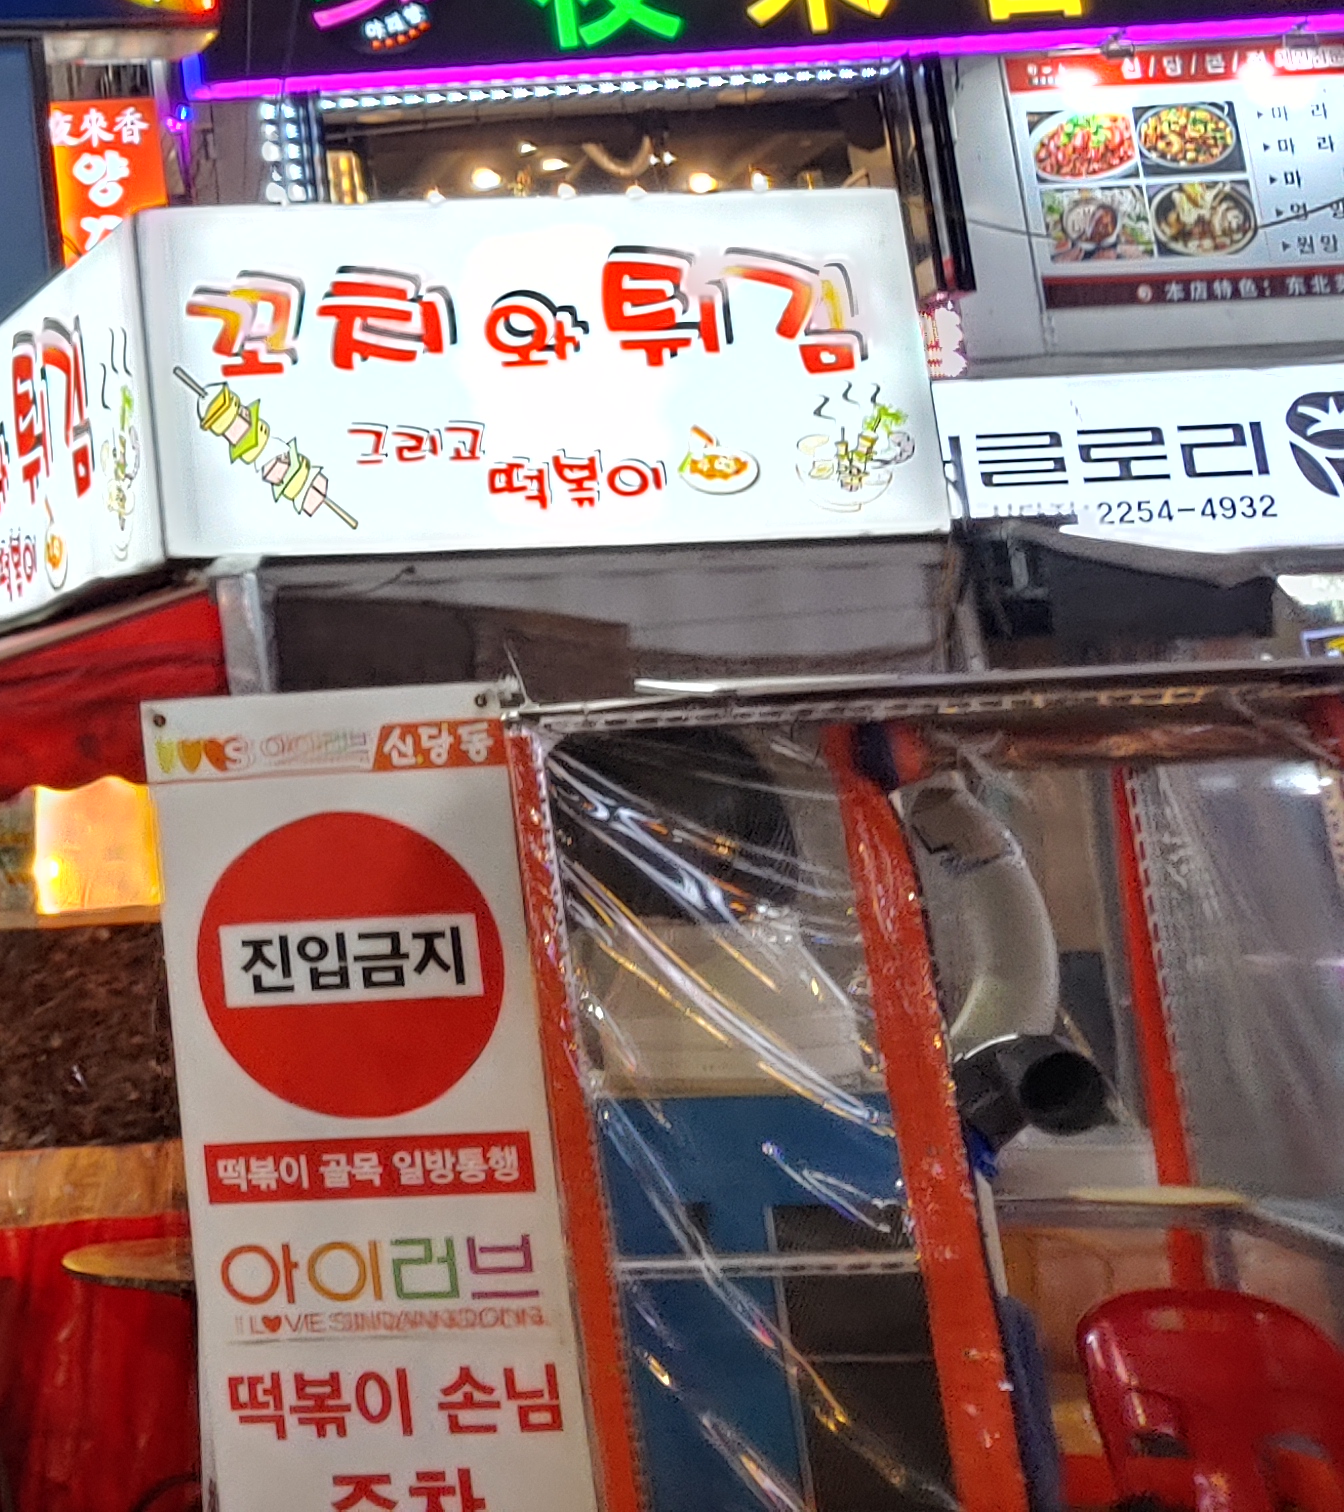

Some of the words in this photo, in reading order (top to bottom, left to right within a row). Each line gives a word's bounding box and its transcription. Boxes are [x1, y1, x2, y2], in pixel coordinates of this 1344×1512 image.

[346, 421, 486, 464] 그리고
[487, 450, 665, 510] 떡볶이
[948, 420, 1271, 488] 글로리
[1097, 493, 1279, 526] 2254-4932
[382, 721, 493, 768] 신당동
[241, 925, 467, 995] 진입금지
[217, 1154, 310, 1193] 떡볶이
[320, 1152, 382, 1188] 골목
[392, 1144, 521, 1184] 일방통행
[220, 1233, 540, 1305] 아이러브
[227, 1367, 413, 1441] 떡볶이
[438, 1362, 564, 1436] 손님
